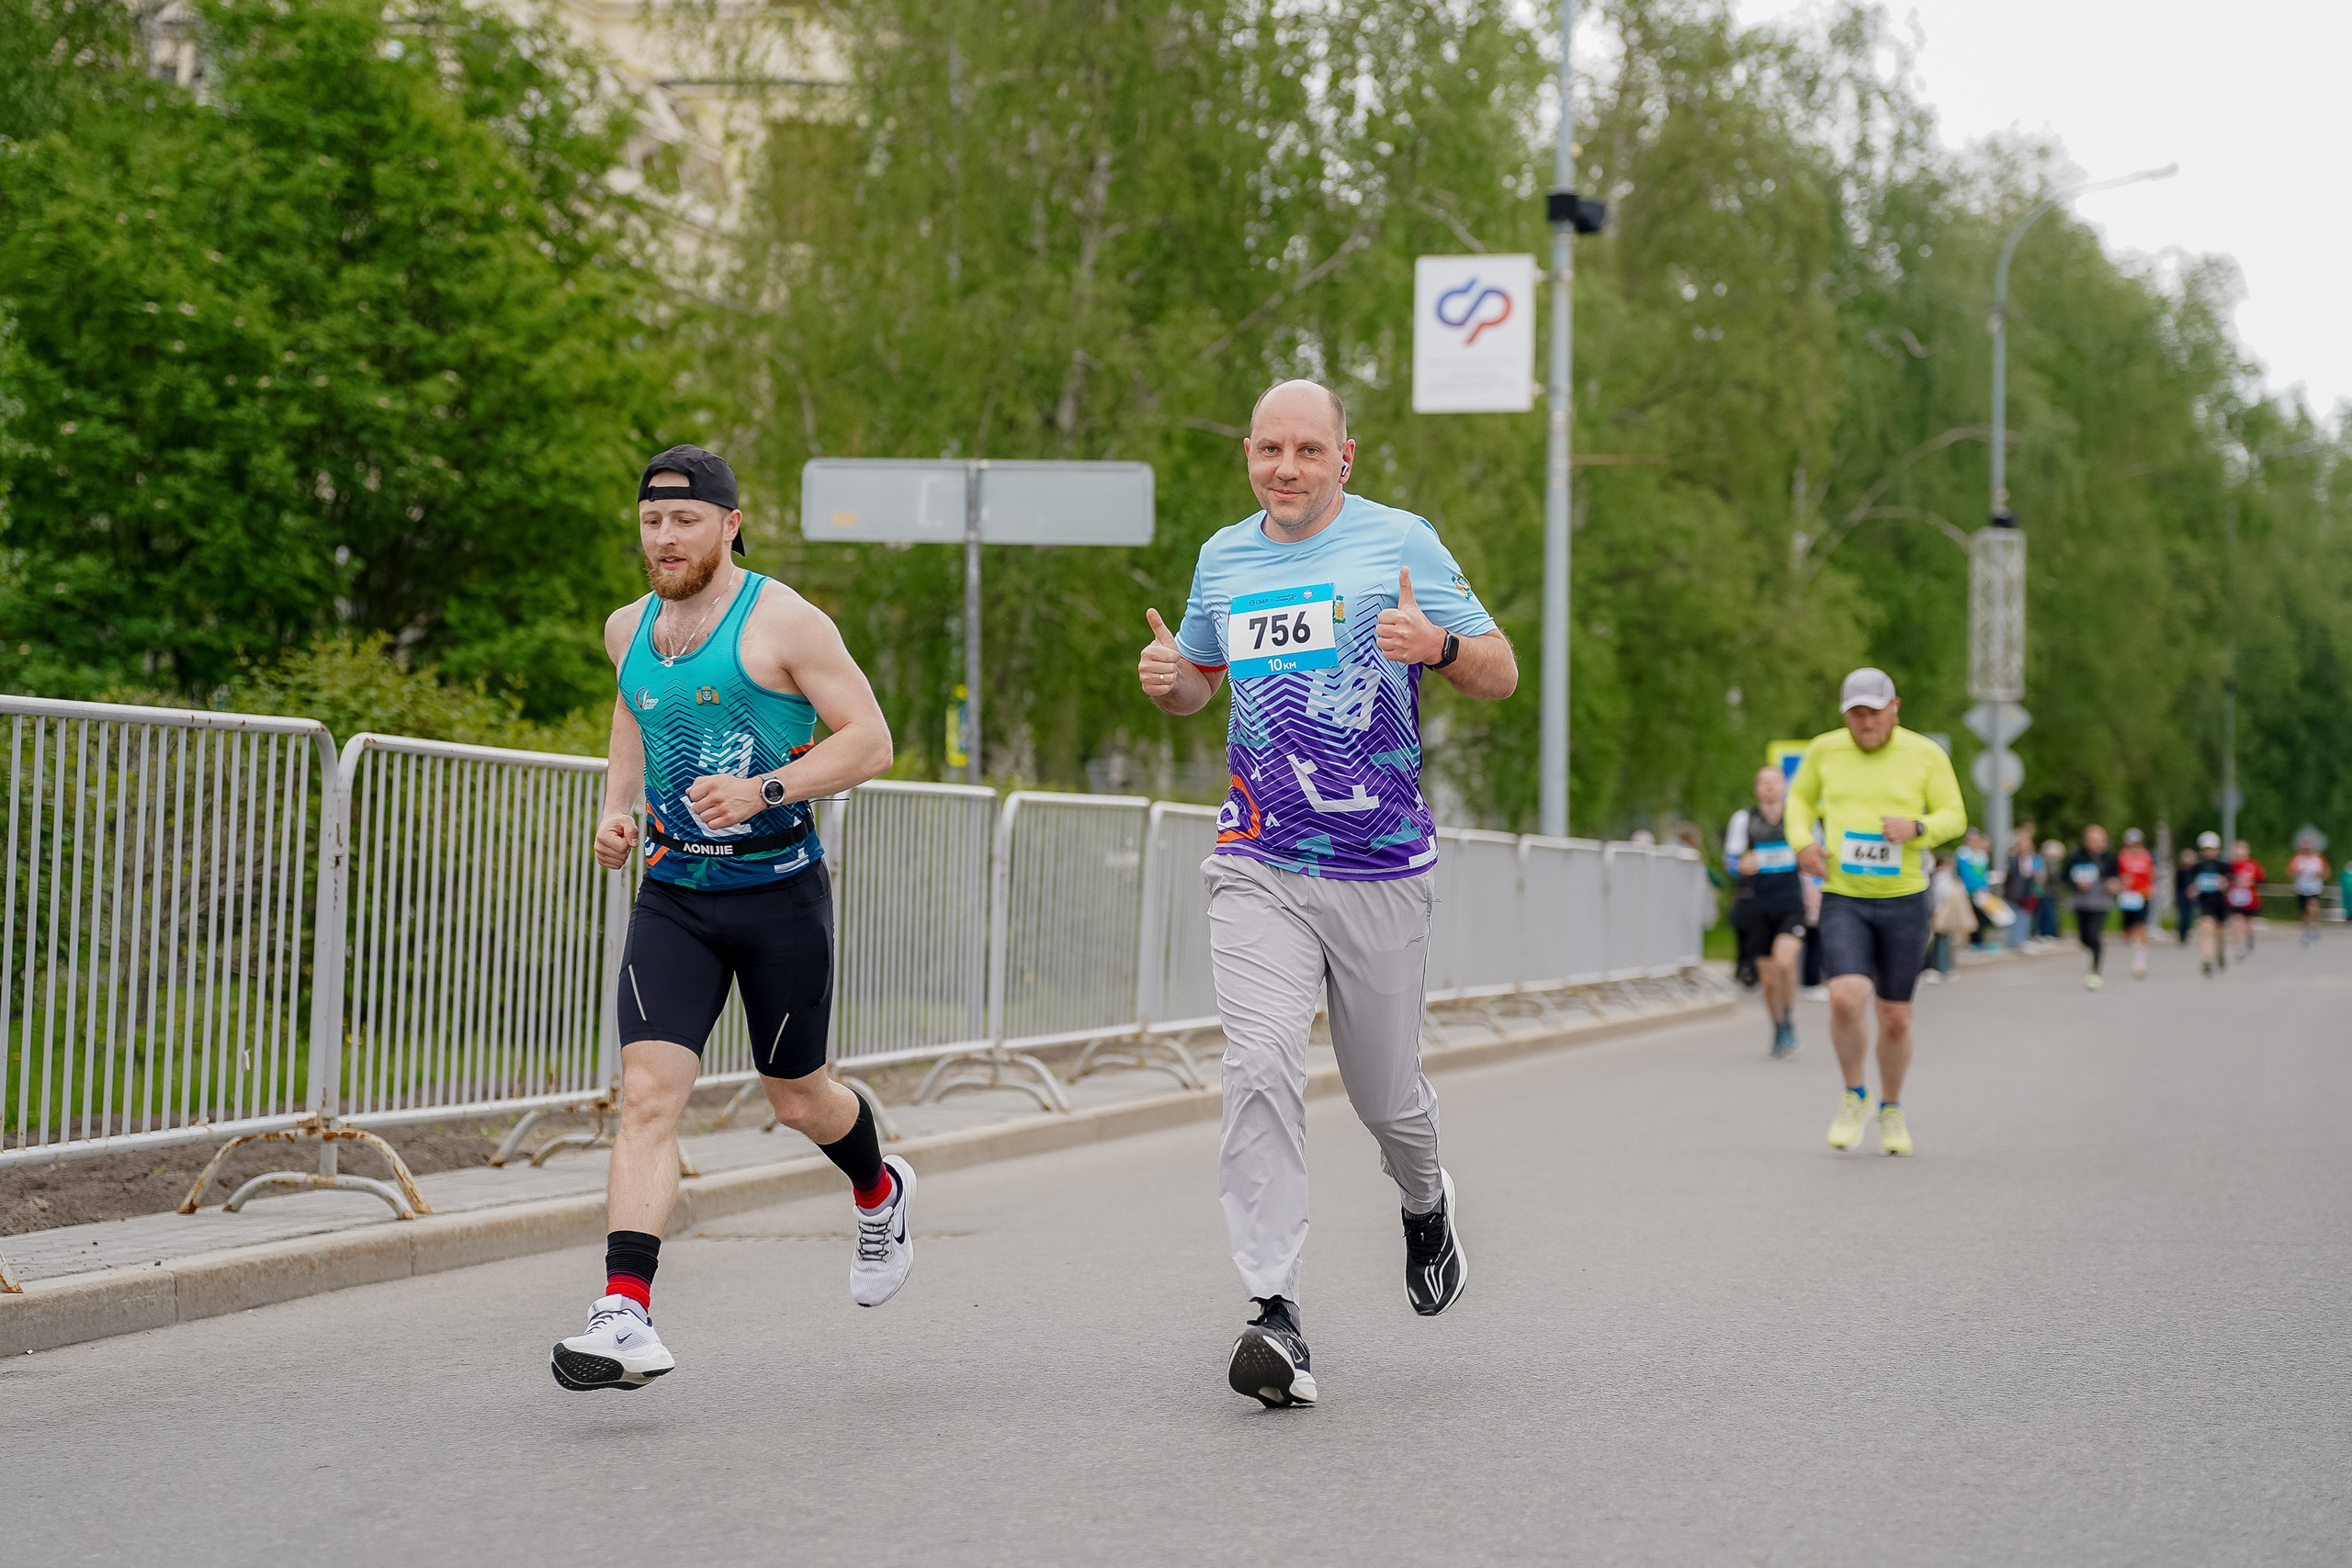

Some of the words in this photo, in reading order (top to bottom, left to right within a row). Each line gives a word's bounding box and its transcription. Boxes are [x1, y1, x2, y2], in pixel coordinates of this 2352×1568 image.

[1249, 610, 1311, 650] 756
[683, 842, 734, 855] AONIJIE
[1854, 846, 1890, 862] 648
